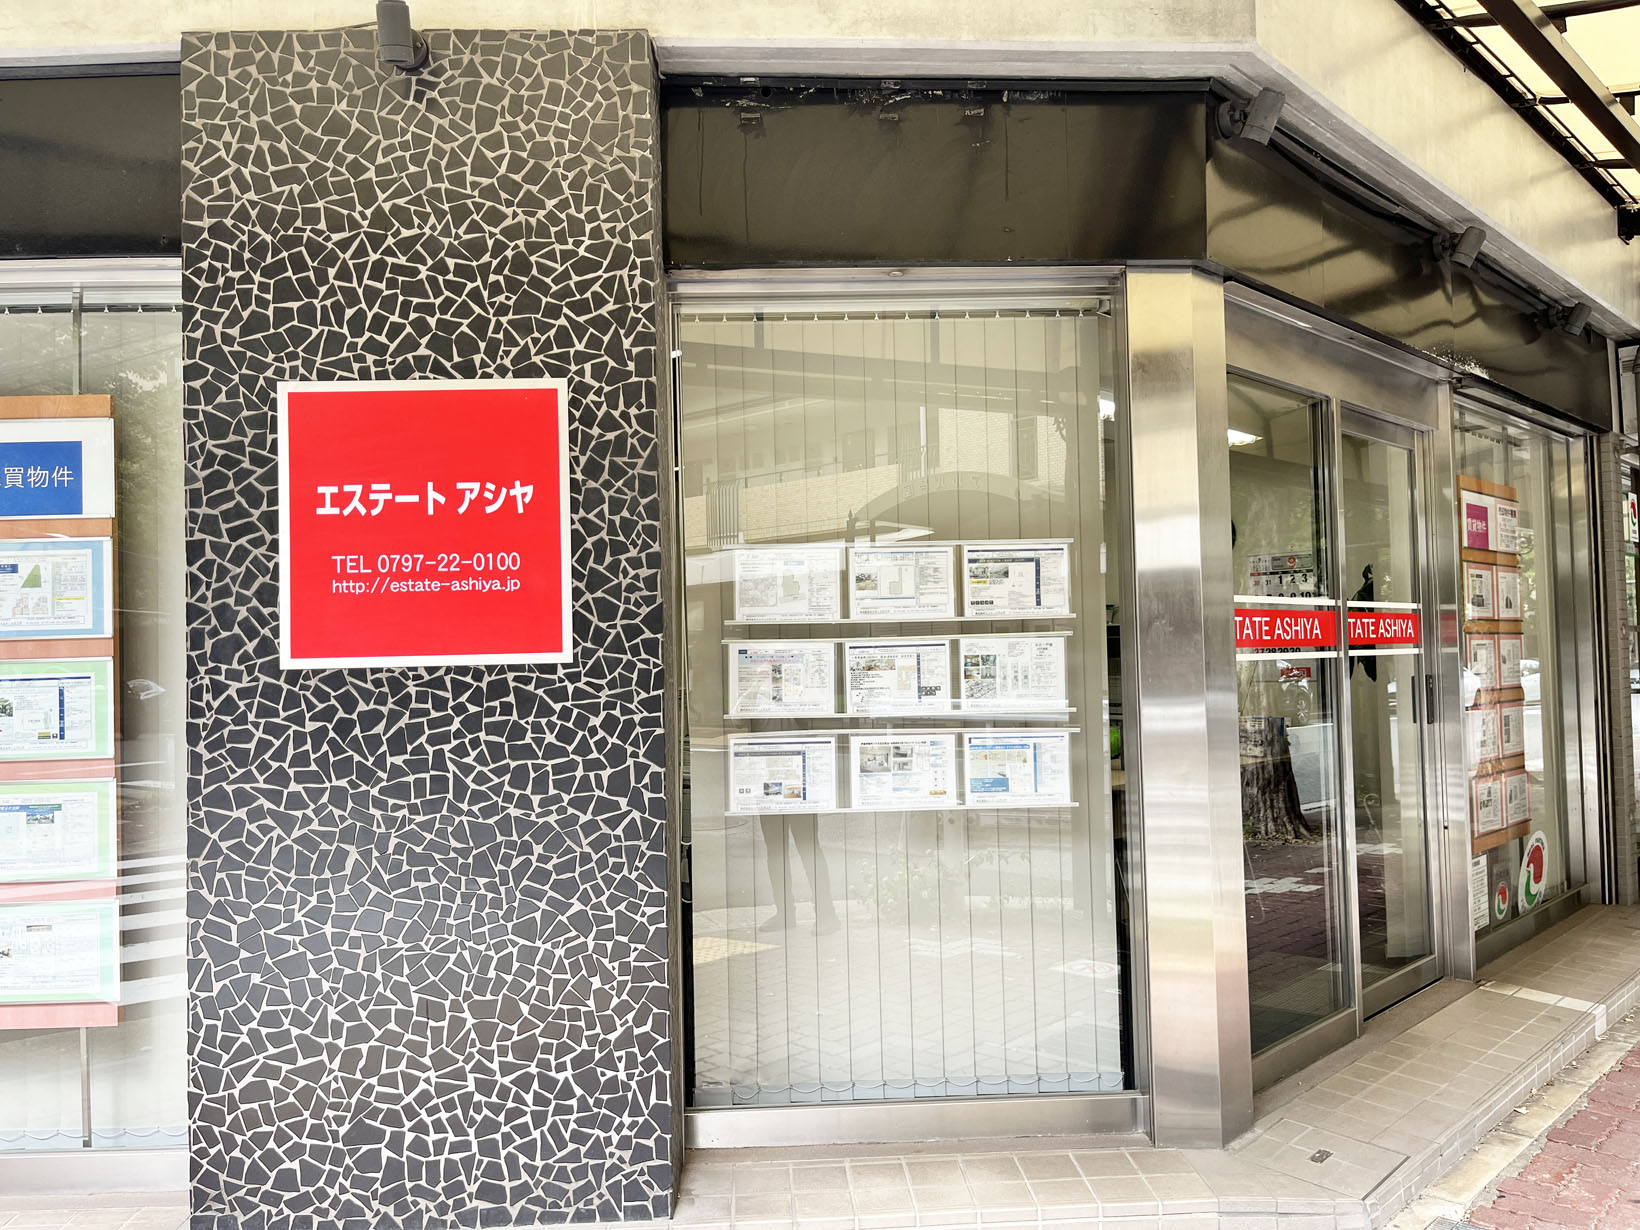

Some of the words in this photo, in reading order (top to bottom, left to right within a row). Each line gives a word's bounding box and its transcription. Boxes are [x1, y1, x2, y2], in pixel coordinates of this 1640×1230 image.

[0, 465, 75, 489] 買物件
[315, 481, 446, 516] エステート
[456, 480, 534, 515] アシヤ
[332, 555, 372, 574] TEL
[377, 552, 521, 574] 0797-22-0100
[332, 576, 521, 595] http://estate-ashiya.jp
[1301, 573, 1308, 583] 3
[1274, 616, 1322, 640] ASHIYA
[1378, 618, 1415, 638] ASHIYA
